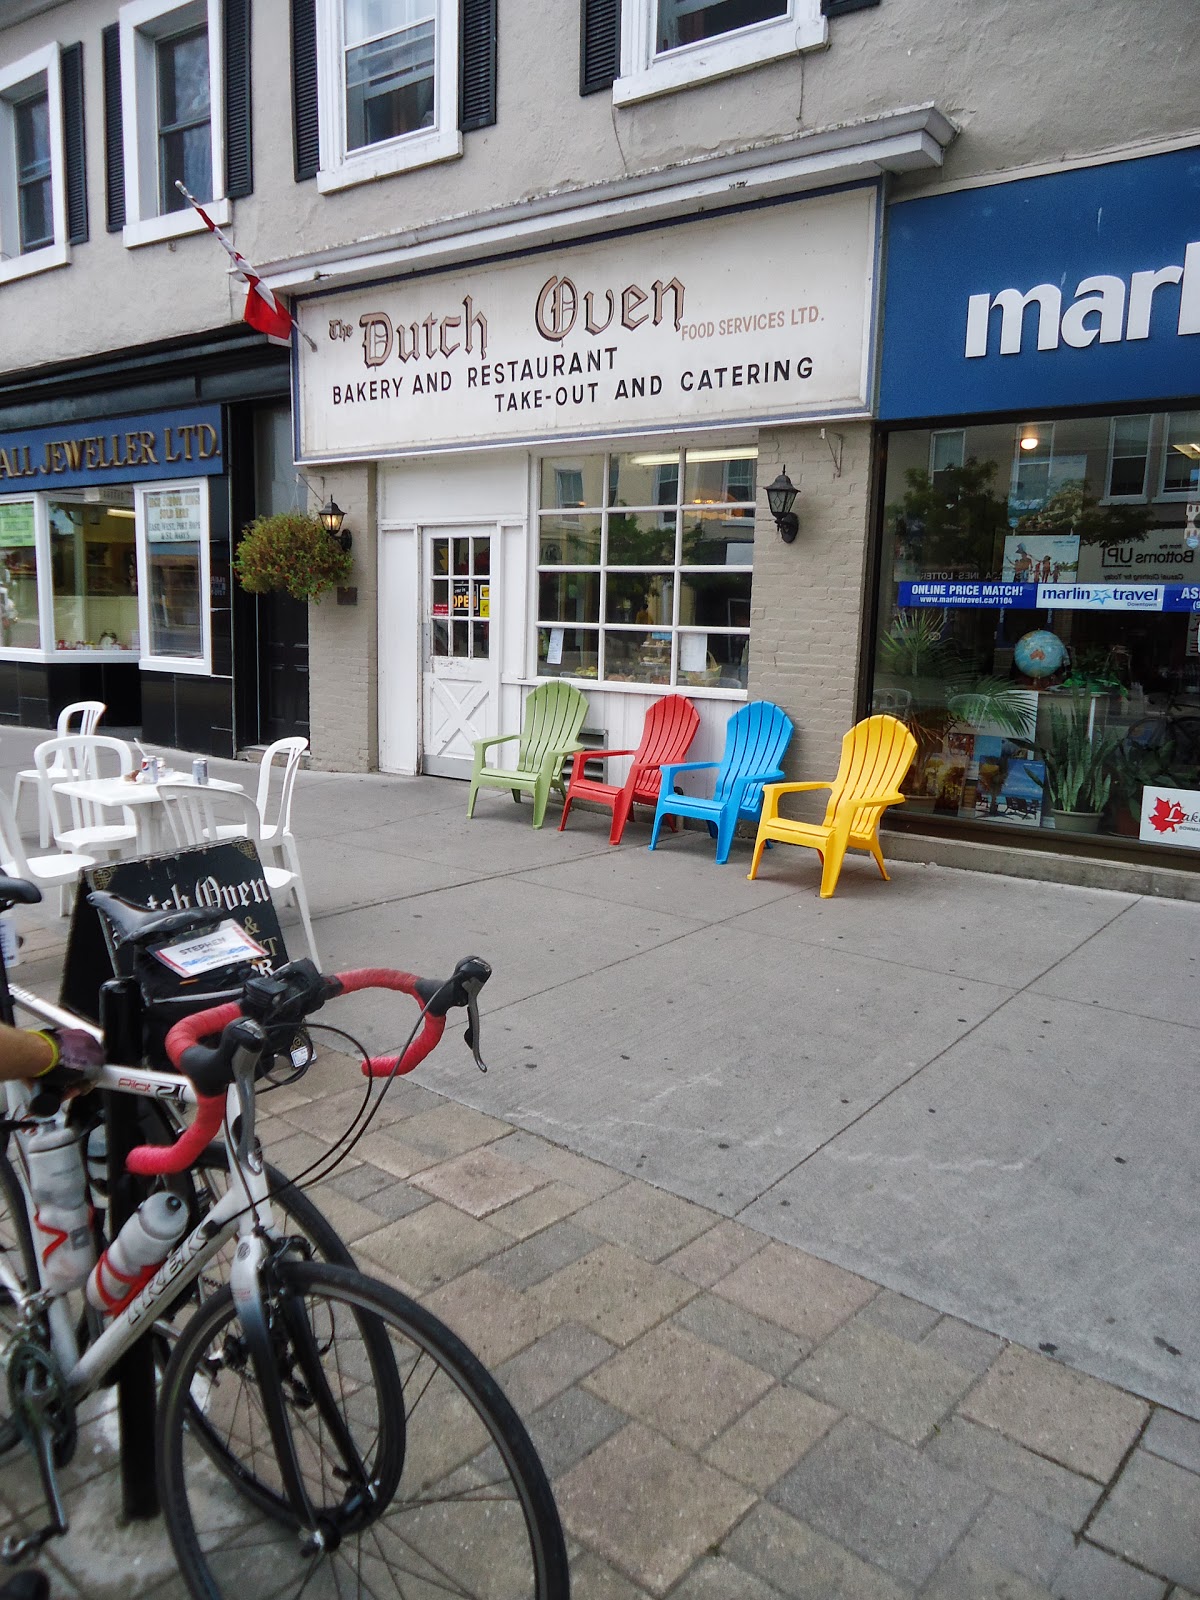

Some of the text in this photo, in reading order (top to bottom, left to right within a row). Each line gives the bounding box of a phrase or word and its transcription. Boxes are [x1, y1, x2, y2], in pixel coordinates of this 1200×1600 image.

[964, 241, 1200, 358] marl
[328, 275, 686, 372] The Dutch Oven
[681, 305, 825, 341] FOOD SERVICES LTD.
[332, 346, 618, 405] BAKERY AND RESTAURANT
[494, 356, 813, 413] TAKE-OUT AND CATERING
[40, 430, 159, 475] JEWELLER
[164, 423, 221, 462] LTD.
[911, 585, 1023, 596] ONLINE PRICE MATCH!
[1042, 587, 1158, 601] marlin travel
[1164, 806, 1200, 823] Lak
[195, 876, 270, 911] Oven
[244, 916, 260, 936] &
[179, 936, 227, 956] STEPHEN
